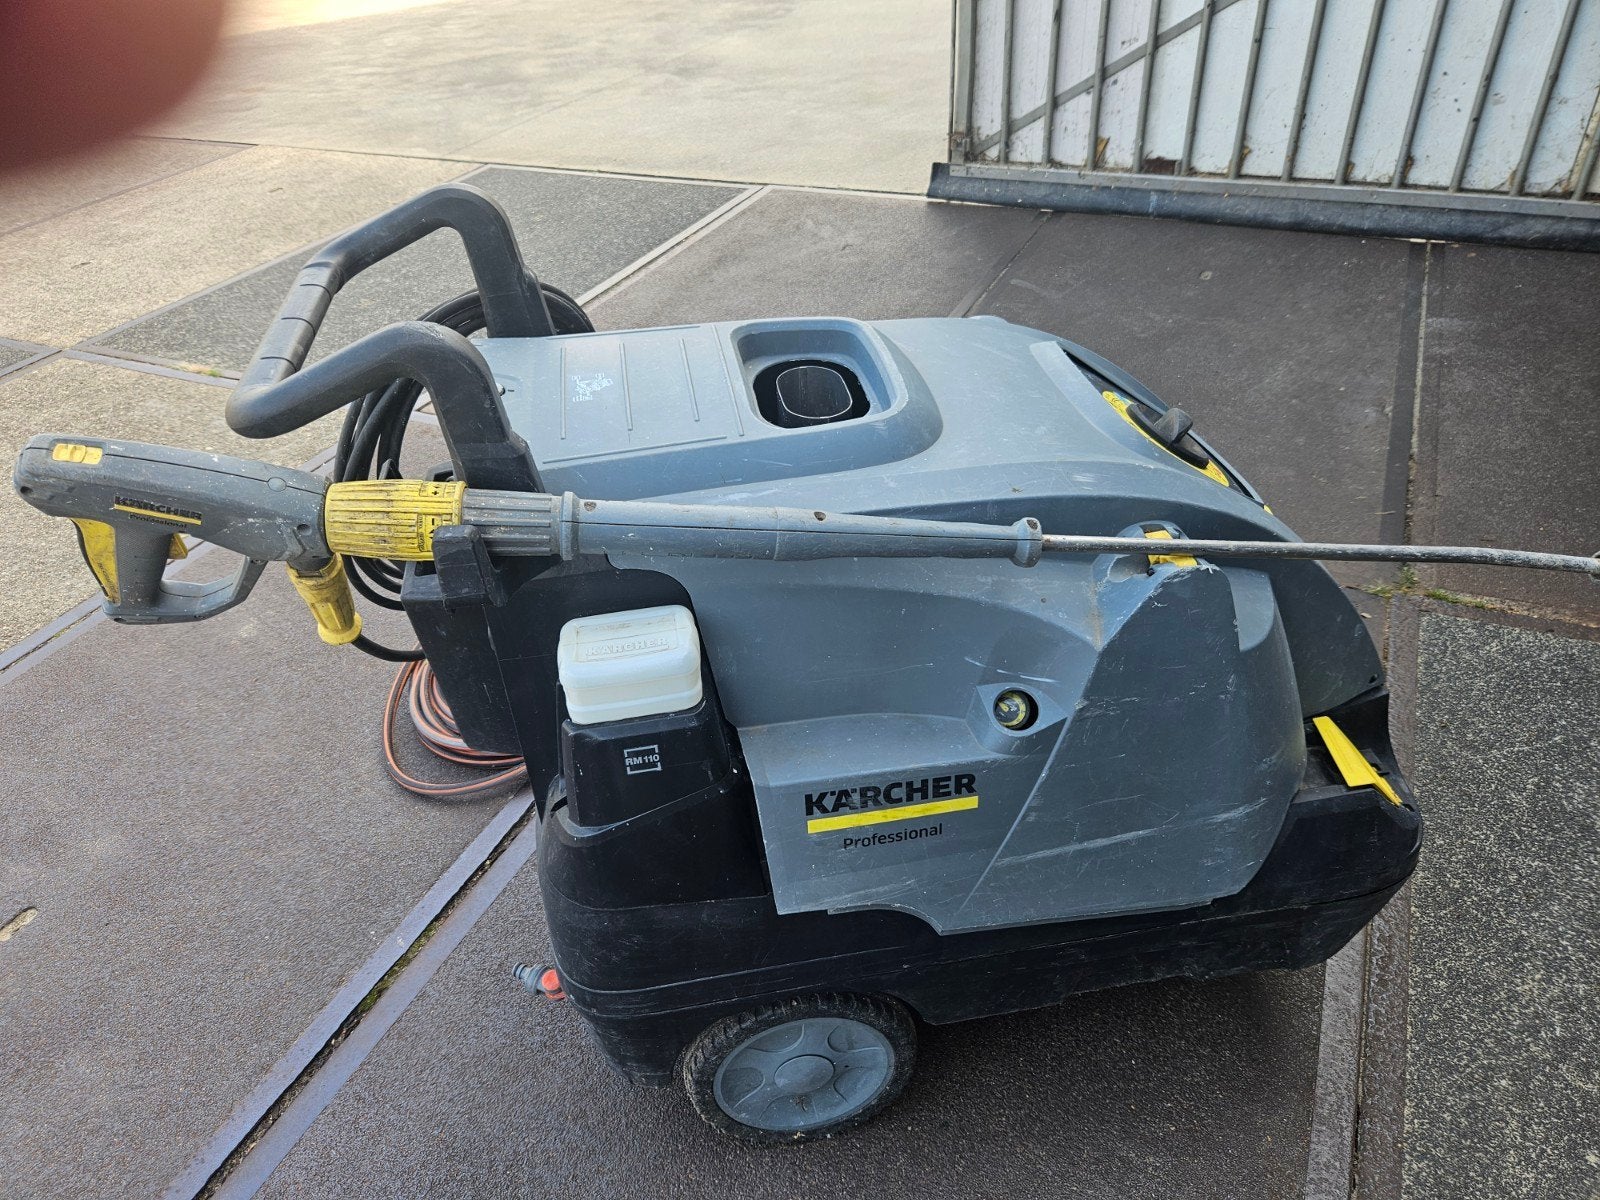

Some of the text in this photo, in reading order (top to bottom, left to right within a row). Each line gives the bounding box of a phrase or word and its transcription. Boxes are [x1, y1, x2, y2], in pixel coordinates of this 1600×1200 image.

[129, 513, 187, 528] Professional
[625, 754, 660, 766] RM 110
[804, 773, 976, 816] KÄRCHER
[843, 822, 943, 849] Professional
